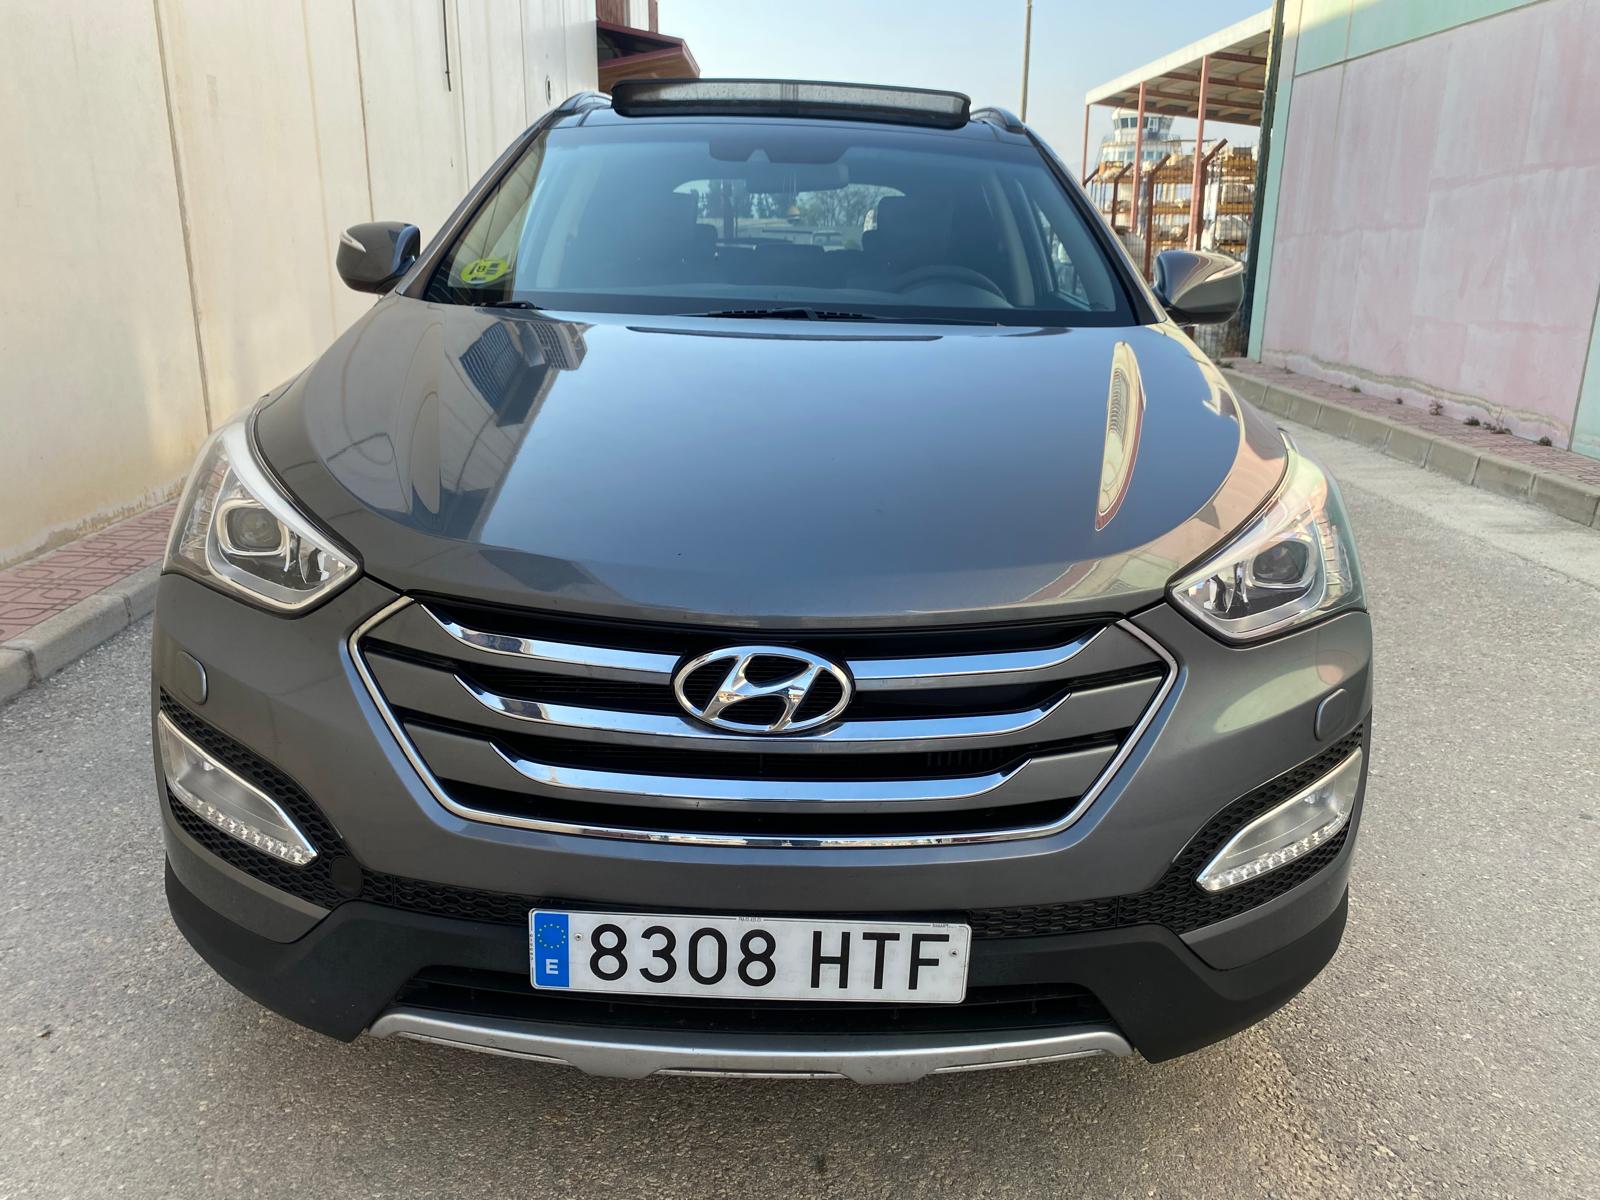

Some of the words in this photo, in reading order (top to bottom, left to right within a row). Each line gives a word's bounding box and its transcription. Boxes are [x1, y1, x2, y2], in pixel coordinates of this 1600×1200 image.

[545, 958, 559, 975] E
[589, 923, 777, 987] 8308
[810, 930, 950, 990] HTF
